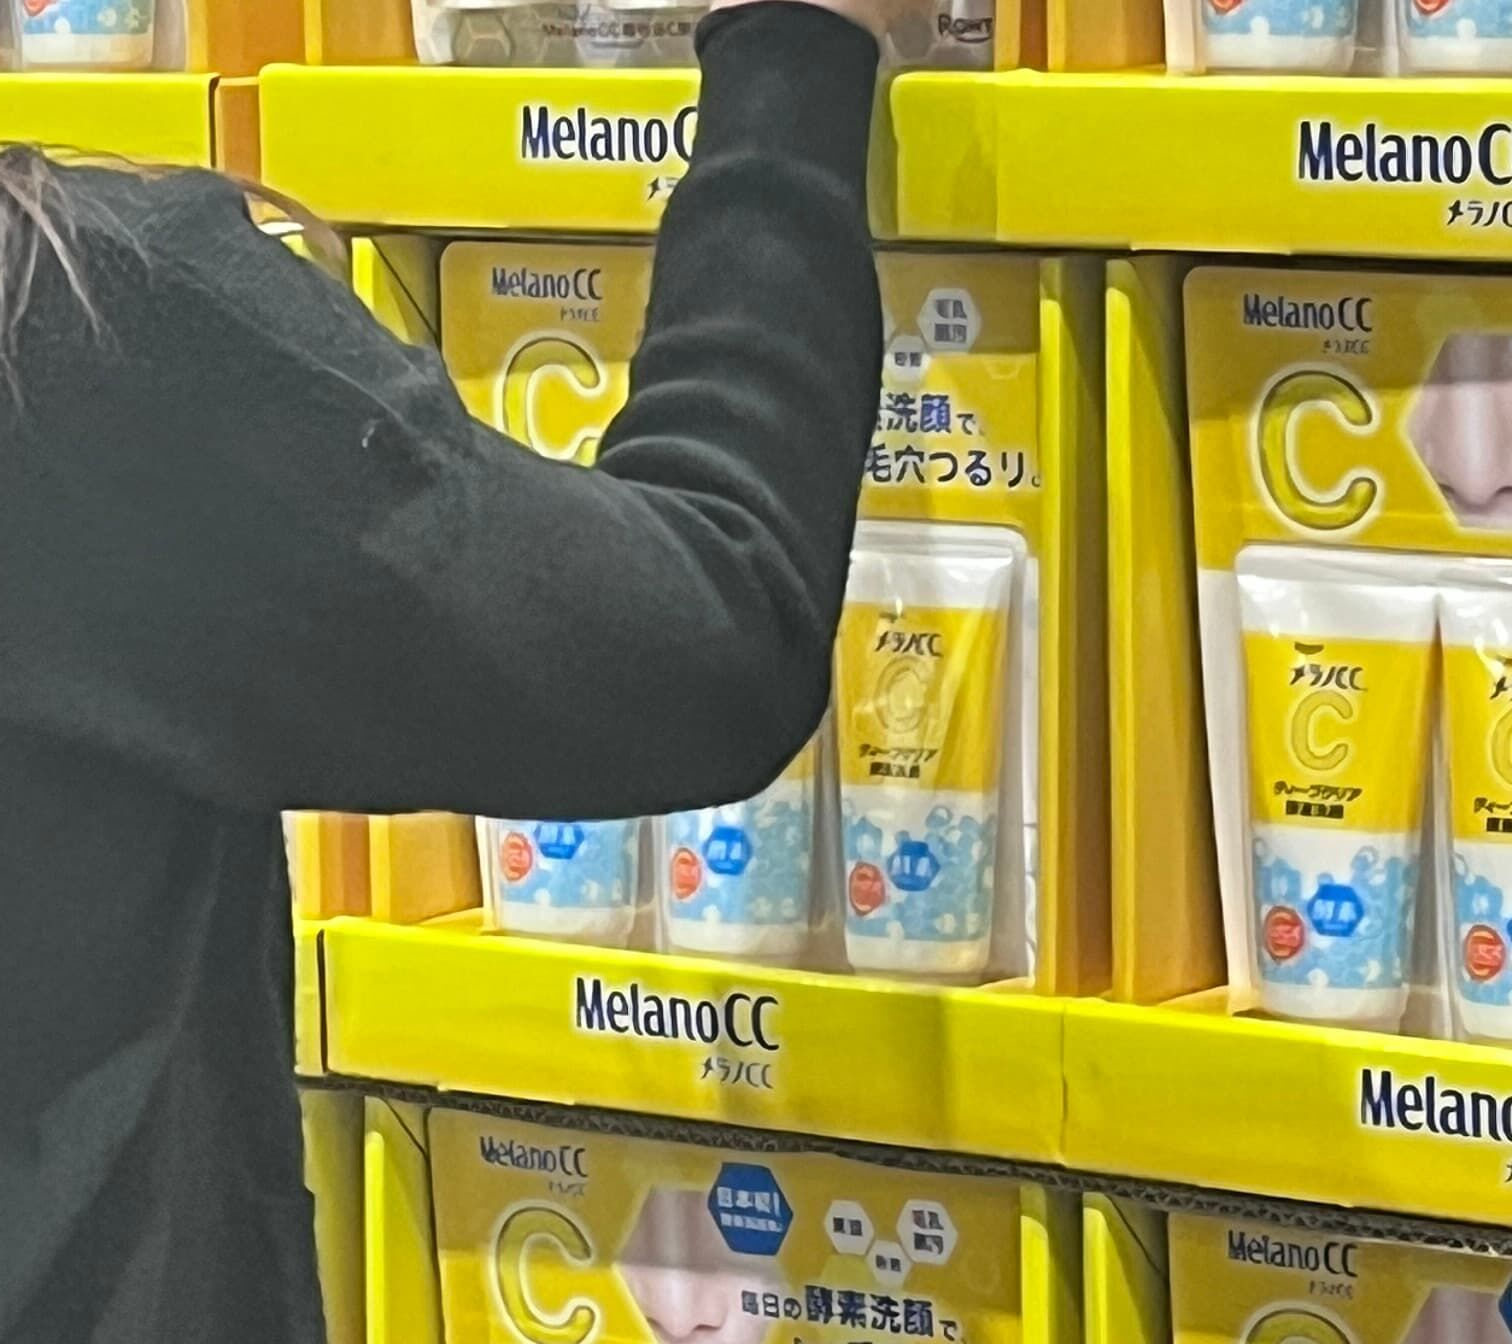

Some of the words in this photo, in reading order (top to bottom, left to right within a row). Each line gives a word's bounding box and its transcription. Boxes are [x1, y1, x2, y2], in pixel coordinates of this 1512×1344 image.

[521, 105, 697, 163] MelanoC
[1297, 119, 1512, 185] MelanoC
[1242, 292, 1374, 333] MelanoCC
[574, 976, 782, 1052] MelanoCC
[1227, 1229, 1359, 1278] MelanoCC
